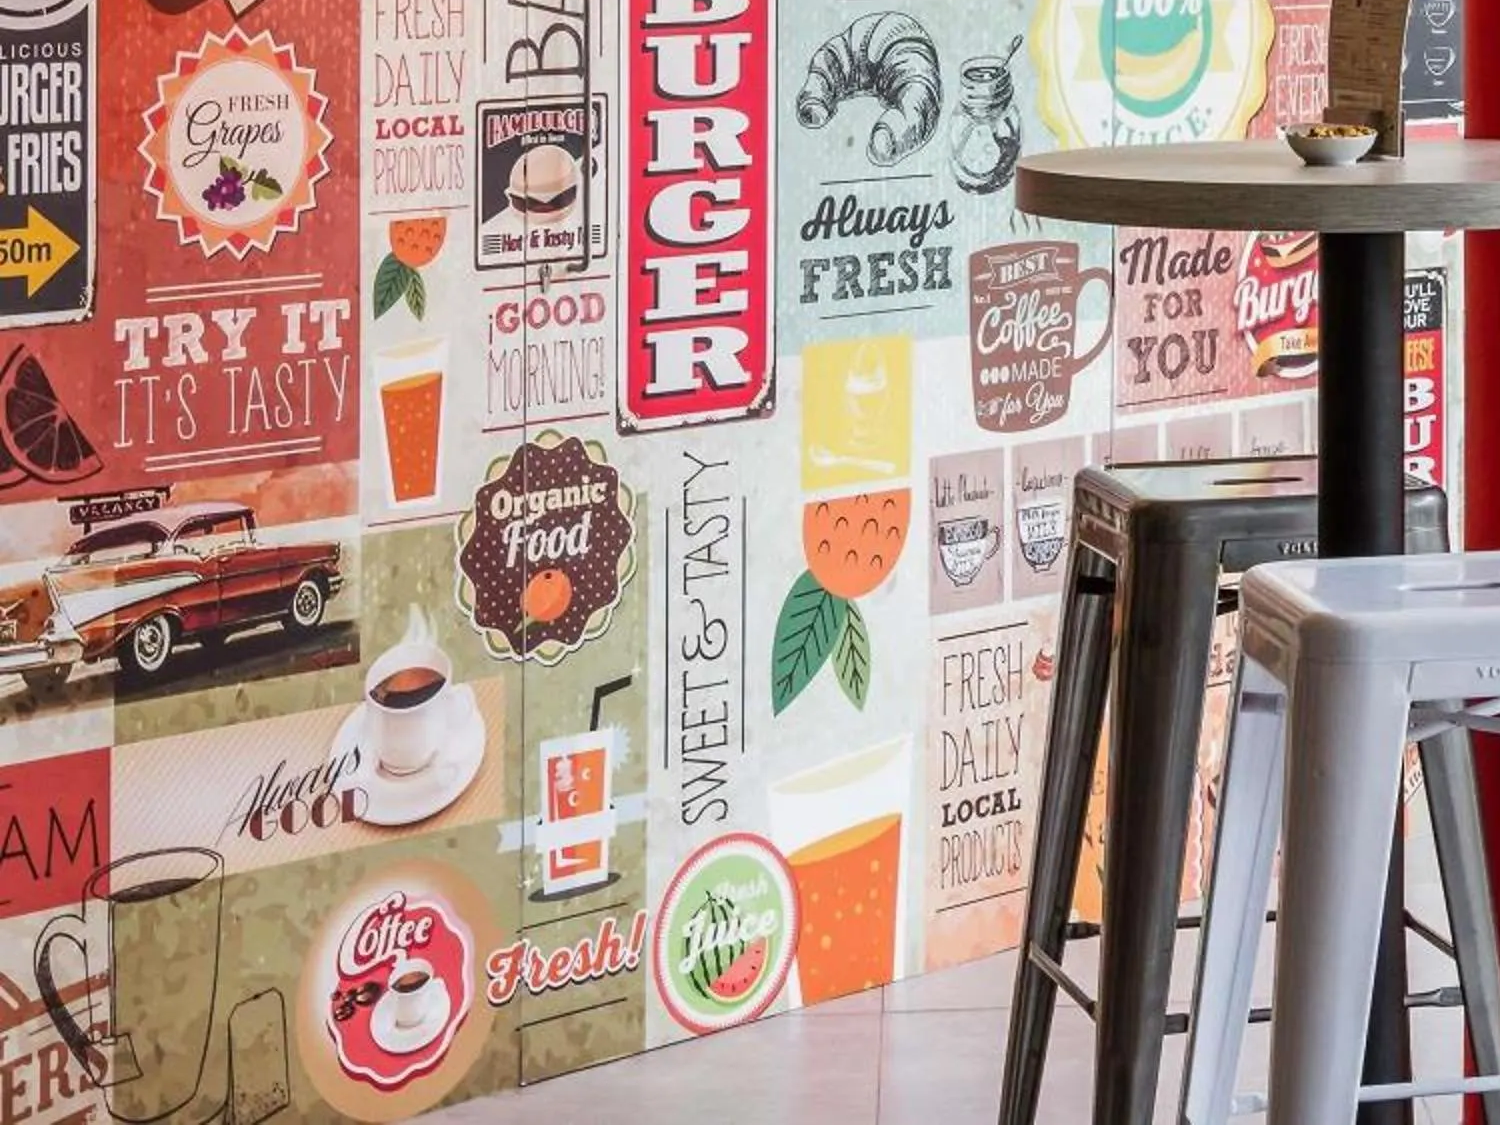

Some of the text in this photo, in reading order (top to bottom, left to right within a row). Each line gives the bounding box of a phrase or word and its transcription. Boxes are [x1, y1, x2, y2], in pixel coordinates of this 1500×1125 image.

[228, 93, 290, 114] FRESH
[373, 50, 466, 107] DAILY
[182, 99, 286, 168] Grapes
[375, 115, 465, 139] LOCAL
[7, 131, 82, 196] FRIES
[373, 144, 465, 196] PRODUCTS
[800, 194, 955, 248] Always
[799, 246, 953, 305] FRESH
[999, 251, 1050, 280] BEST
[1119, 233, 1233, 286] Made
[976, 288, 1074, 360] Coffee
[1143, 288, 1204, 324] FOR
[1404, 298, 1431, 313] OVE
[1404, 314, 1427, 328] UR
[114, 298, 350, 372] TRY IT
[1127, 327, 1219, 384] YOU
[487, 335, 606, 415] MORNING!
[1011, 356, 1063, 382] MADE
[113, 355, 350, 449] IT'S TASTY
[1000, 383, 1066, 427] for You
[490, 476, 609, 525] Organic
[683, 450, 731, 595] TASTY
[501, 511, 592, 569] Food
[681, 598, 729, 663] &
[942, 641, 1024, 716] FRESH
[681, 670, 730, 826] SWEET
[939, 714, 1024, 792] DAILY
[214, 743, 362, 847] Always
[249, 785, 369, 842] GOOD
[941, 787, 1022, 828] LOCAL
[940, 819, 1023, 889] PRODUCTS
[338, 891, 432, 978] Coffee
[487, 908, 649, 1008] Fresh!
